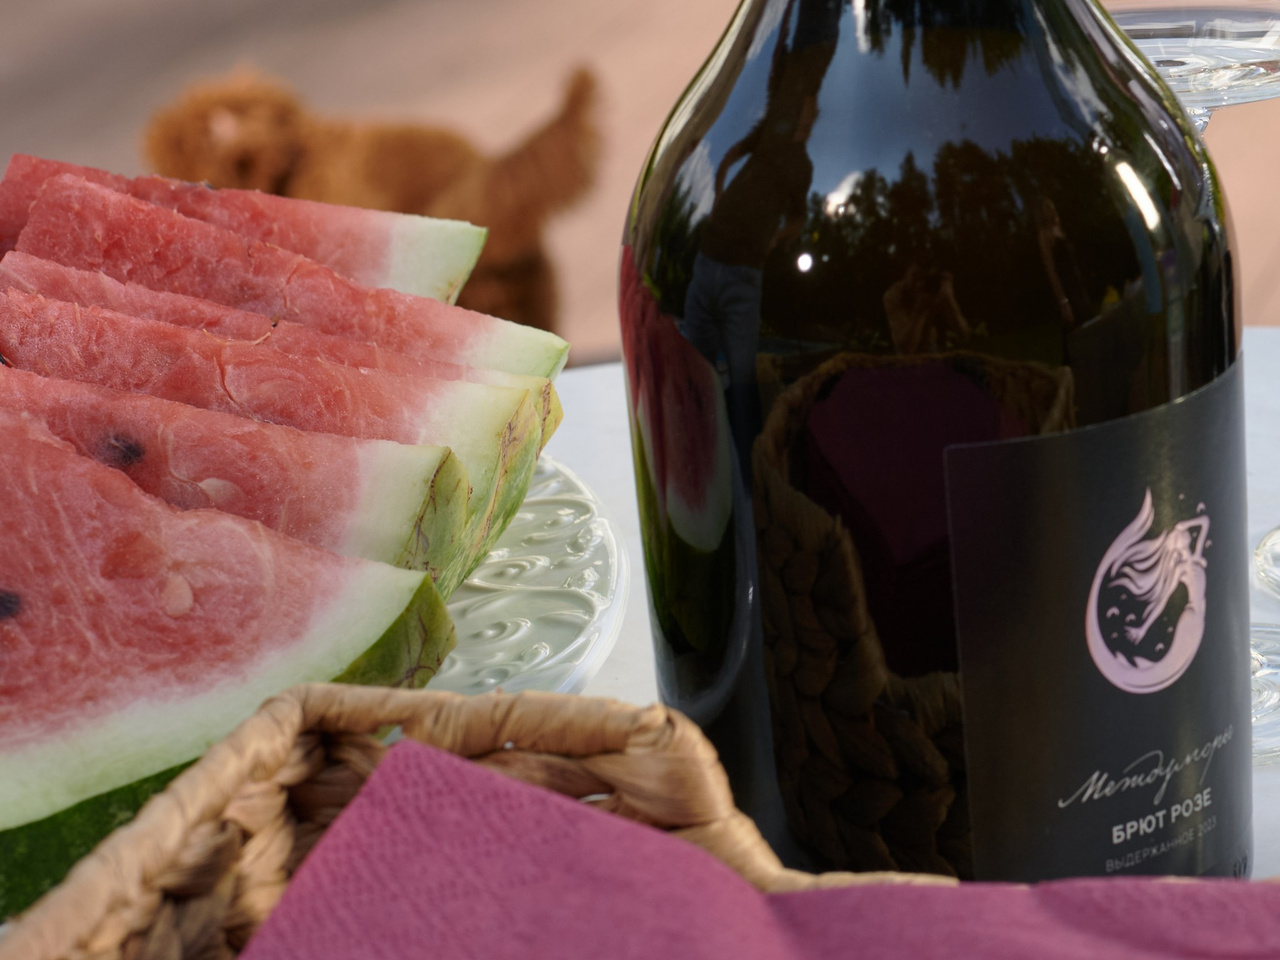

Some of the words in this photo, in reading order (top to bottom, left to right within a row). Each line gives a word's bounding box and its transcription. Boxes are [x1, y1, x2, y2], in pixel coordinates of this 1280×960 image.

[1111, 809, 1166, 844] БРЮТ
[1170, 787, 1213, 823] РОЗЕ
[1105, 827, 1195, 873] ВЫДЕРЖАННОЕ
